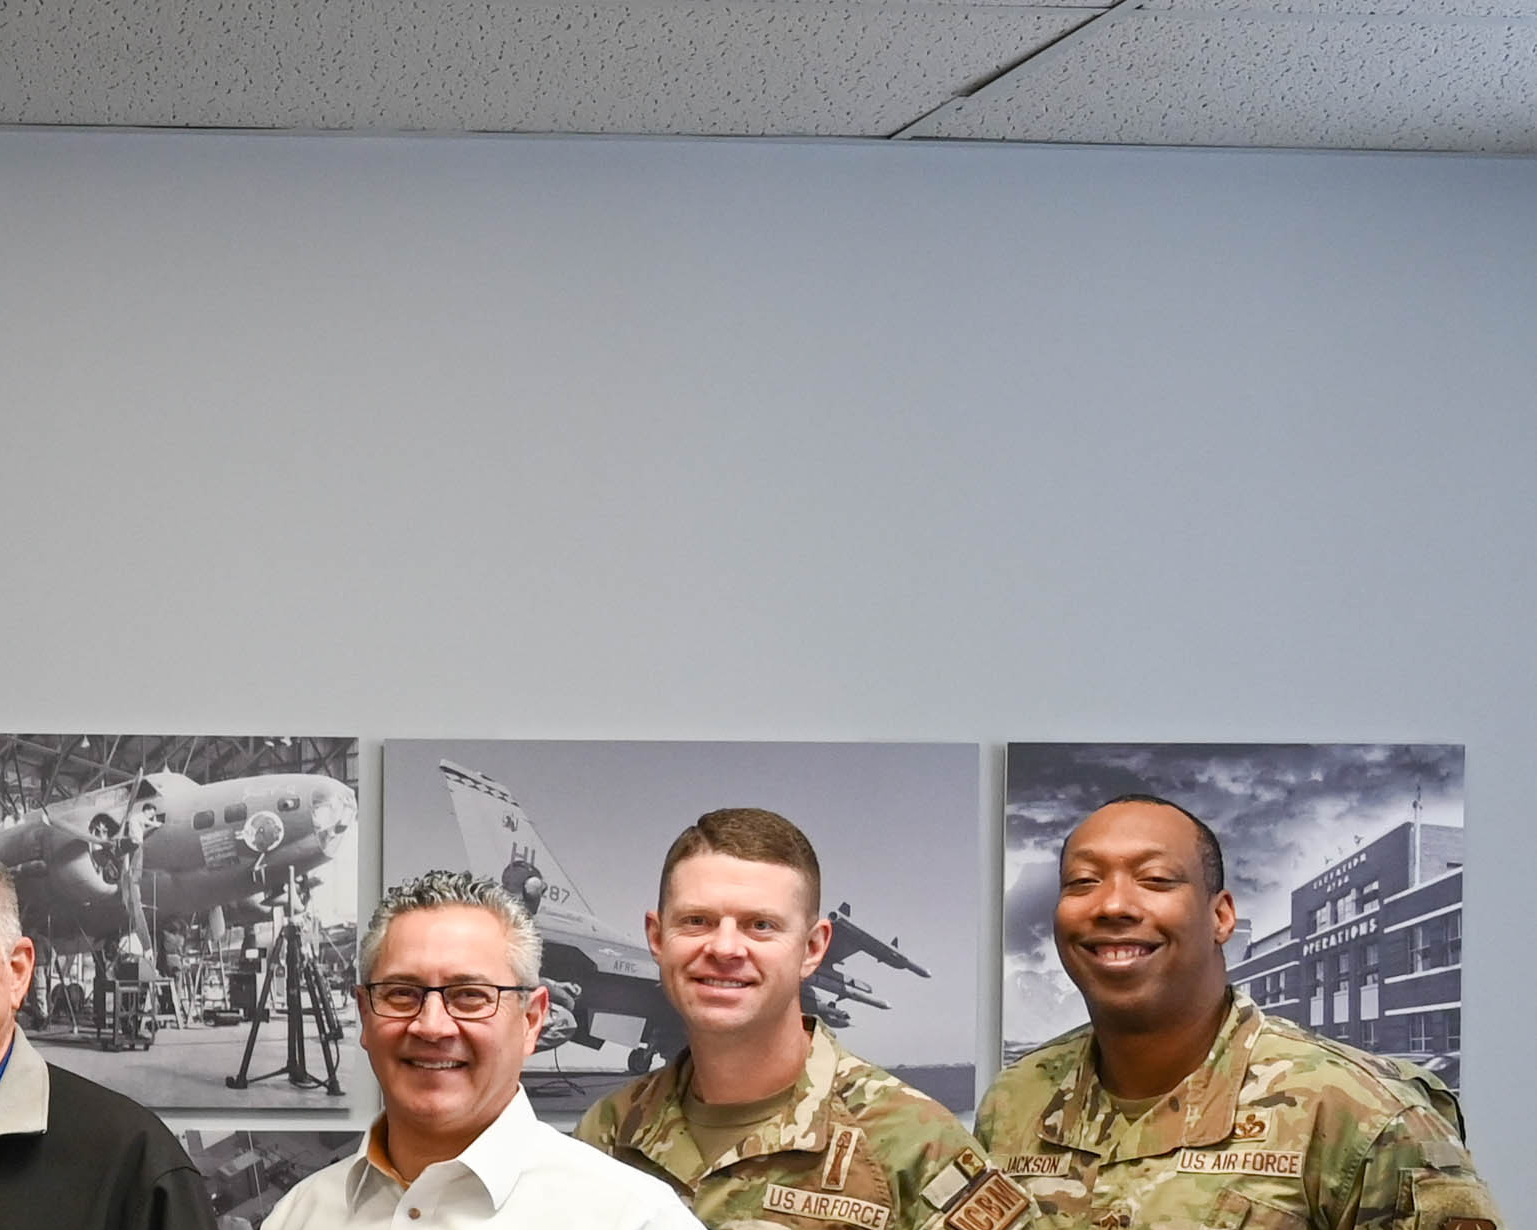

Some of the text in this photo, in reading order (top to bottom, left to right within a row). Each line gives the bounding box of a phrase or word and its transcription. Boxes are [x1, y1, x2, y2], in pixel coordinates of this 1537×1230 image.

[1303, 918, 1378, 957] OPERATIONS
[1002, 1156, 1060, 1174] JACKSON
[1211, 1153, 1238, 1171] AIR
[1241, 1152, 1299, 1174] FORCE
[801, 1195, 830, 1217] AIR
[830, 1199, 884, 1228] FORCE
